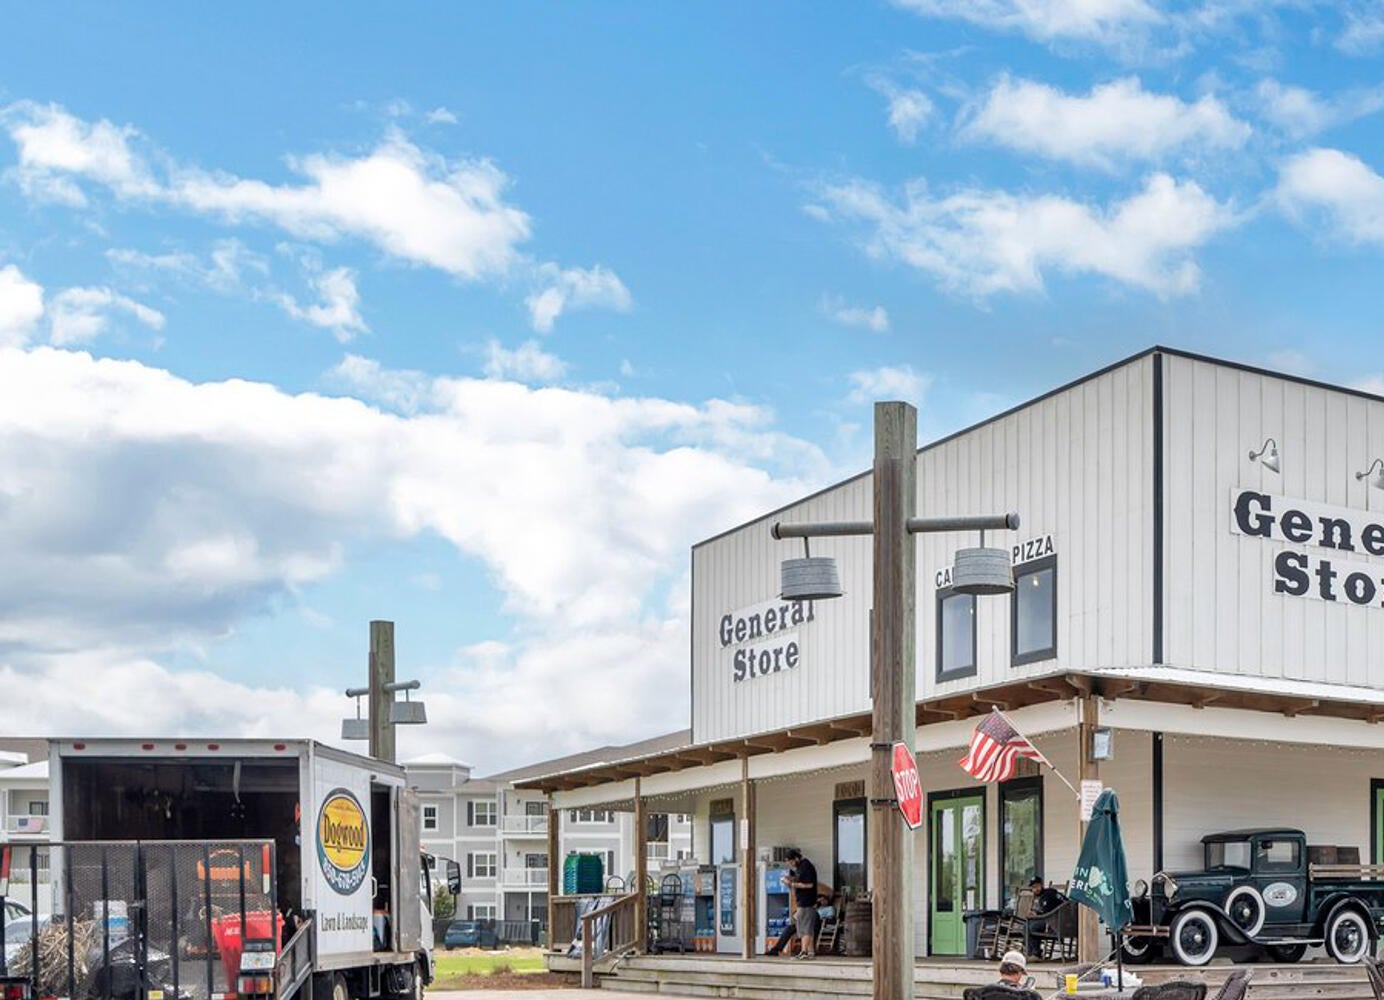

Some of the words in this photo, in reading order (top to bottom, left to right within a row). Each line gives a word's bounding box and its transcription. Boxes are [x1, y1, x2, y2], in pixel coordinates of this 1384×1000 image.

[1012, 535, 1054, 564] PIZZA
[719, 598, 815, 648] General
[733, 641, 799, 683] Store
[895, 768, 918, 802] STOP
[323, 814, 365, 853] Dogwood
[321, 912, 336, 932] Lawn
[341, 912, 368, 934] Landscape
